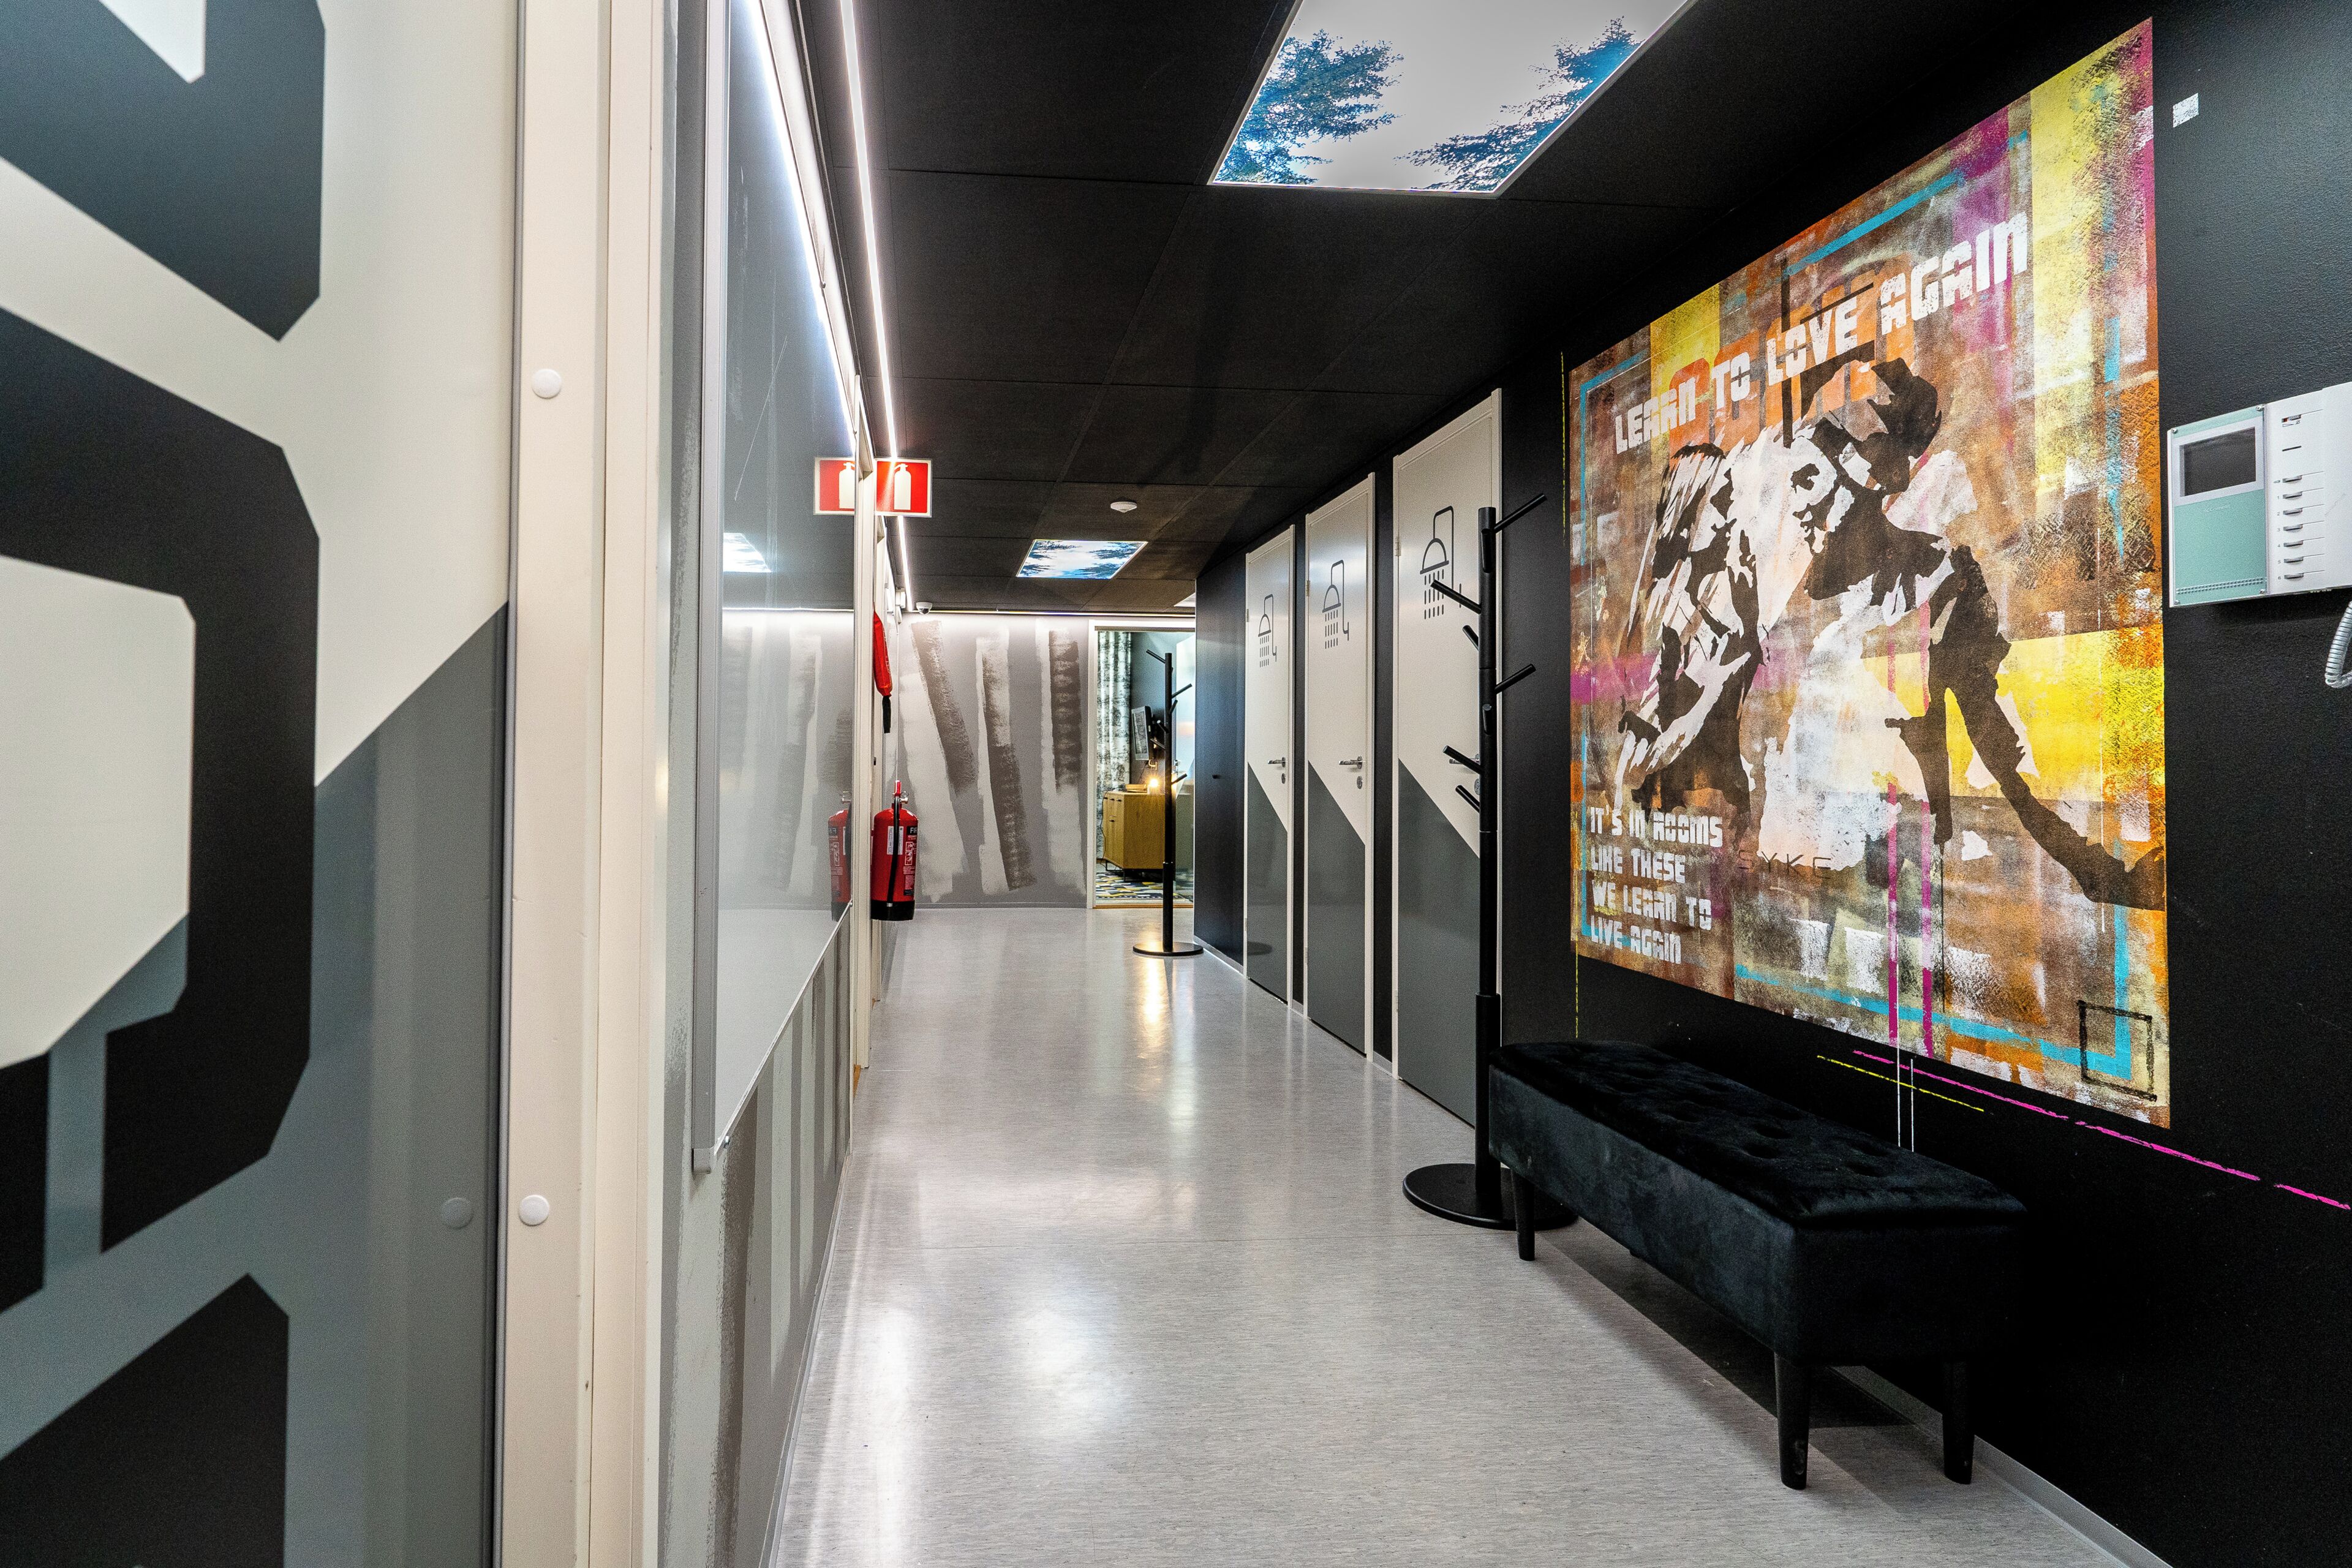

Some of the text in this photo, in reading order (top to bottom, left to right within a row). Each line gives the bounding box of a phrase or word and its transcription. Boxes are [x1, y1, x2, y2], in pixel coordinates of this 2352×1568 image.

[1615, 211, 2027, 454] LEARN TO LOVE AGAIN
[1590, 806, 1723, 848] IT'S IN ROOMS
[1591, 845, 1686, 883] LIKE THESE
[1738, 850, 1831, 879] SYKE
[1592, 881, 1712, 931] WE LEARN TO
[1591, 915, 1681, 965] LIVE AGAIN
